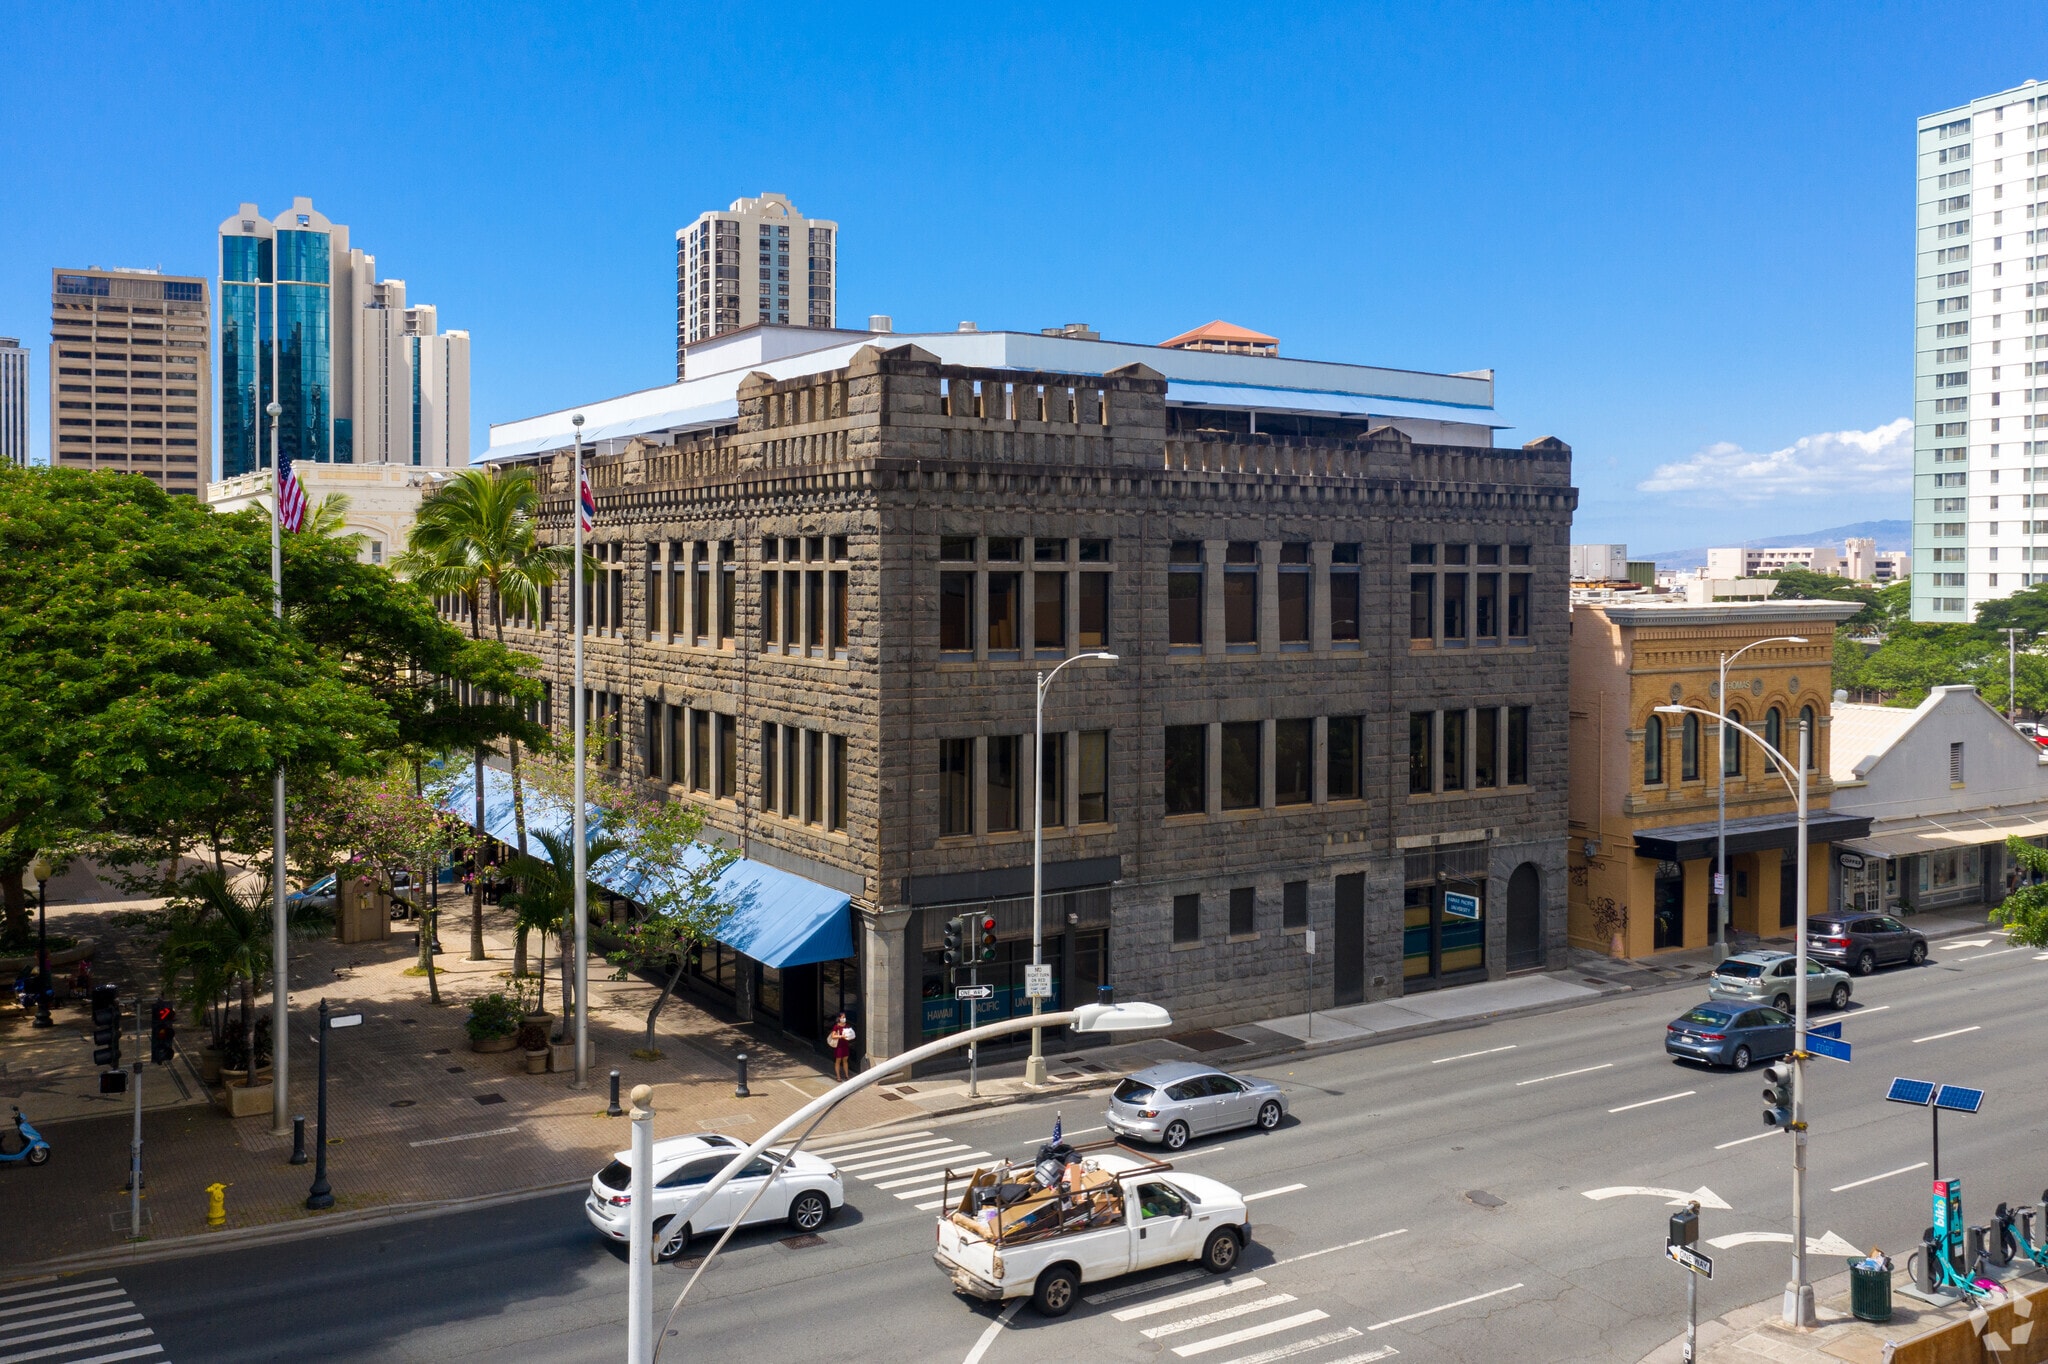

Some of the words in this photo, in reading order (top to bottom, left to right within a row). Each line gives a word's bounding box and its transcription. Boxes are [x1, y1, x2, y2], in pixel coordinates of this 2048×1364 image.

[1724, 681, 1750, 690] THOMAS
[1841, 857, 1861, 865] COFFEE
[927, 1008, 953, 1021] HAWAII
[975, 1001, 1000, 1013] ACIFIC
[1816, 1043, 1833, 1055] FORT
[1935, 1202, 1945, 1227] biki
[1680, 1250, 1693, 1263] ONE
[1694, 1257, 1708, 1269] WAY
